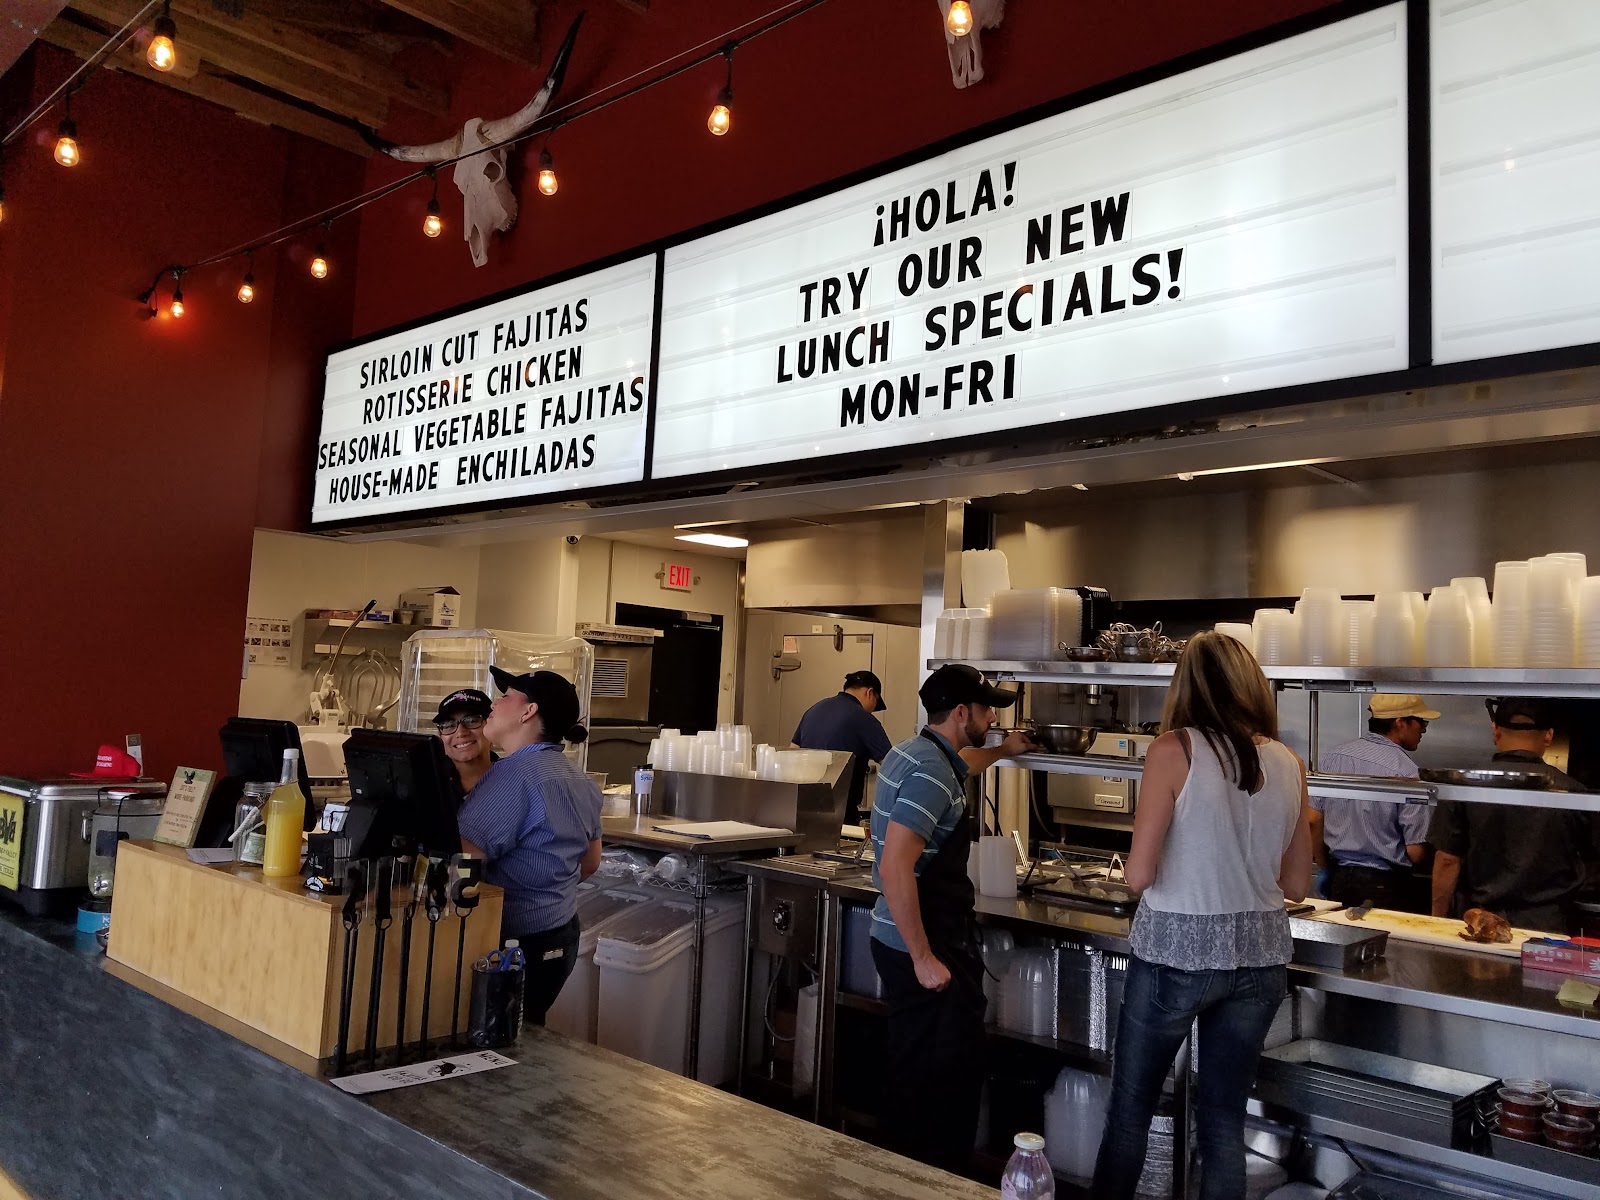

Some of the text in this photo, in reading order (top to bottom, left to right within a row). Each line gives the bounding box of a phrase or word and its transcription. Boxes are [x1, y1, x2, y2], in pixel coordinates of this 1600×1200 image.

[873, 160, 1017, 248] ¡HOLA!
[799, 191, 1131, 323] TRY OUR NEW
[359, 298, 588, 390] SIRLOIN CUT FAJITAS
[777, 247, 1184, 384] LUNCH SPECIALS!
[318, 376, 644, 470] SEASONAL VEGETABLE FAJITAS
[363, 345, 582, 425] ROTISSERIE CHICKEN
[840, 353, 1016, 428] MON-FRI
[328, 433, 596, 504] HOUSE-MADE ENCHILADAS
[669, 564, 692, 588] EXIT
